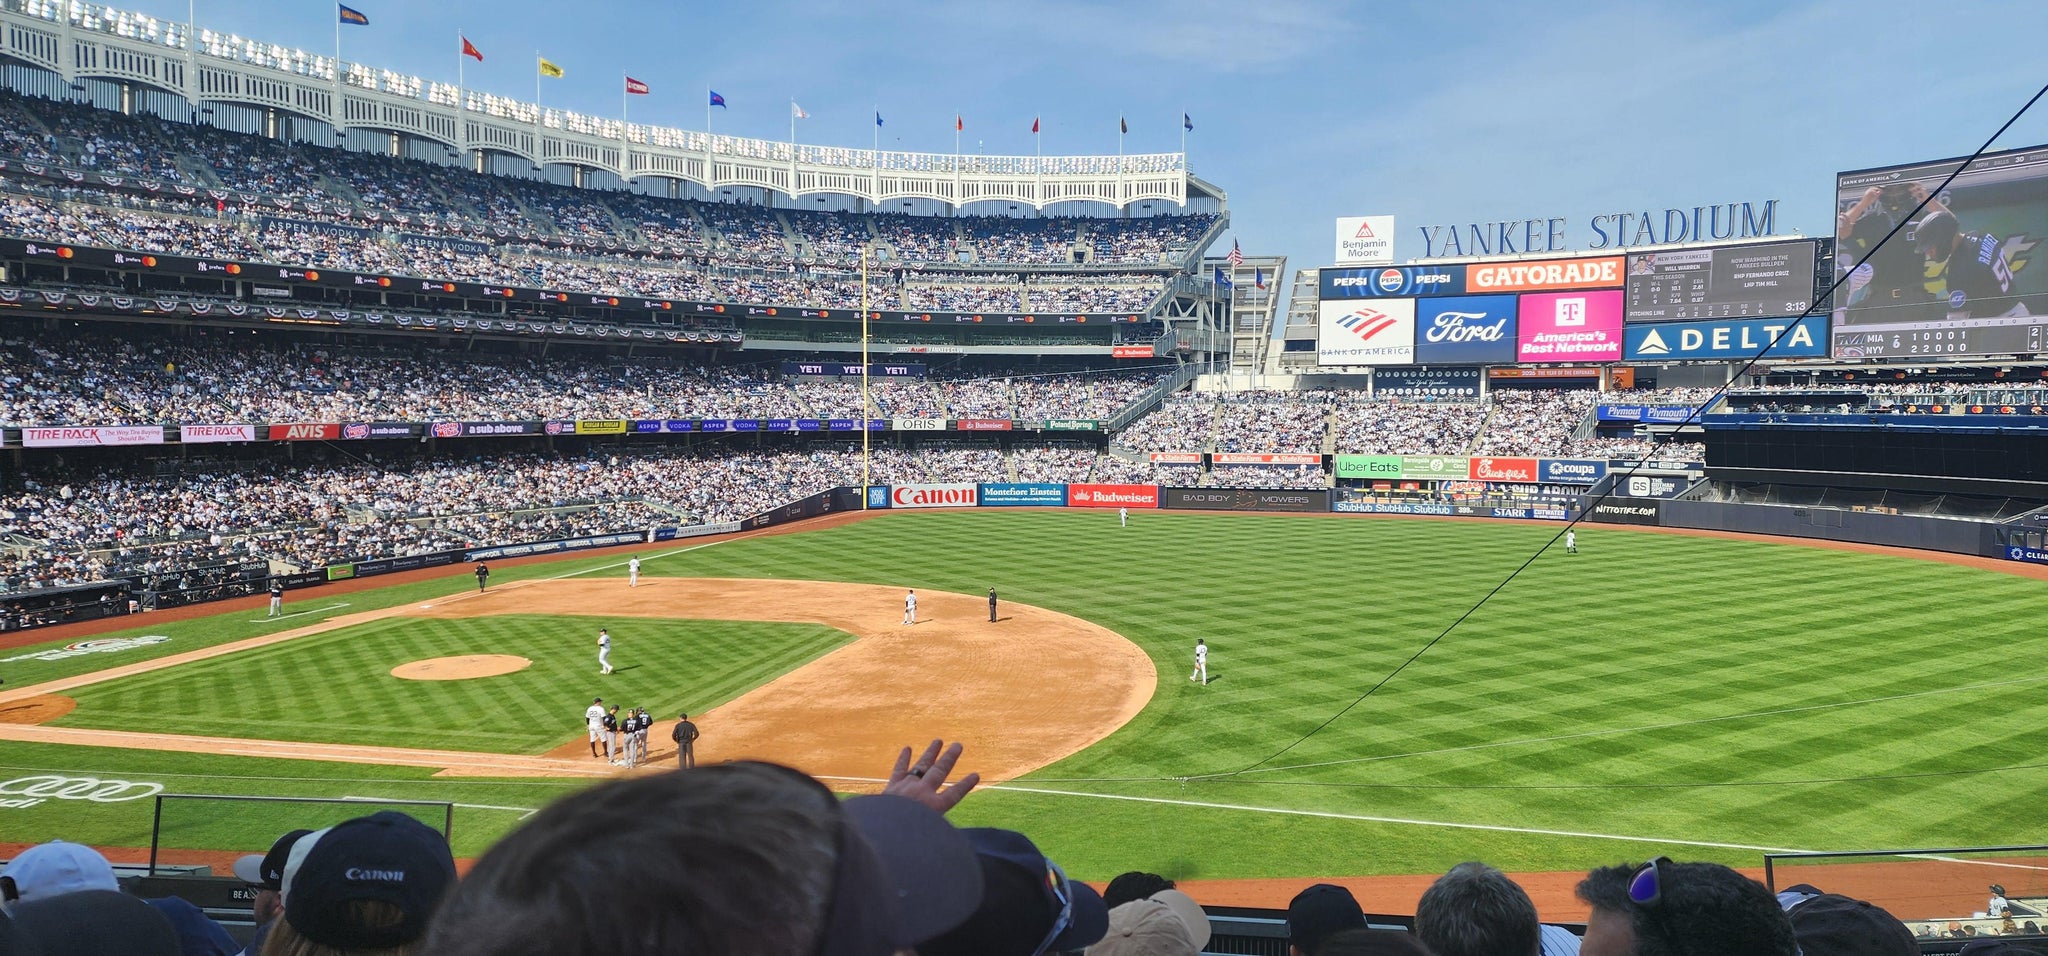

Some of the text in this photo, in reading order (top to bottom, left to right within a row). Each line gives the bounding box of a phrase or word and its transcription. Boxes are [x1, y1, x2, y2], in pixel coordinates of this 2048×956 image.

[1864, 175, 1890, 184] AMERICA
[268, 220, 360, 239] ASPEN VODKA
[1416, 198, 1780, 258] YANKEE STADIUM
[406, 237, 483, 253] ASPEN VODKA
[1342, 238, 1387, 249] Benjamin
[1347, 249, 1379, 257] Moore
[1416, 274, 1450, 284] PEPSI
[1475, 261, 1617, 287] GATORADE
[1333, 277, 1368, 286] PEPSI
[1785, 301, 1806, 311] 3:13
[1426, 312, 1507, 342] Ford
[1533, 331, 1606, 343] America's
[1680, 324, 1814, 351] DELTA
[1867, 328, 2038, 343] MIA 1 0 0 0 1 2
[1521, 341, 1619, 354] Best Network
[1866, 341, 2038, 354] NYY 2 2 0 0 0 4
[1893, 340, 1900, 349] 6
[1365, 348, 1411, 356] AMERICA
[799, 365, 822, 373] YETI
[885, 366, 908, 375] YETI
[1647, 407, 1688, 418] Plymouth
[476, 424, 494, 433] sub
[495, 424, 523, 433] above
[903, 419, 936, 430] ORIS
[1050, 420, 1093, 431] Poland Spring
[29, 428, 102, 443] TIRE RACK
[187, 426, 247, 440] TIRE RACK
[286, 425, 324, 439] AVIS
[1164, 454, 1196, 462] State Farm
[1281, 455, 1298, 463] State
[1339, 461, 1368, 472] Uber
[1370, 462, 1399, 472] Eats
[1563, 464, 1595, 476] coupa
[1632, 482, 1647, 490] GS
[893, 487, 975, 505] Canon
[984, 487, 1061, 496] Montefiore Einstein
[1183, 494, 1230, 502] BAD BOY
[1261, 496, 1309, 504] MOWERS
[1337, 503, 1372, 512] StubHub
[1375, 504, 1411, 513] StubHub
[1414, 505, 1450, 514] StubHub
[1494, 508, 1526, 517] STARR
[1595, 504, 1656, 517] NITTOTIRE.COM
[240, 562, 267, 571] StubHub
[589, 710, 598, 718] 22
[345, 867, 405, 881] Canon
[233, 890, 242, 899] BE
